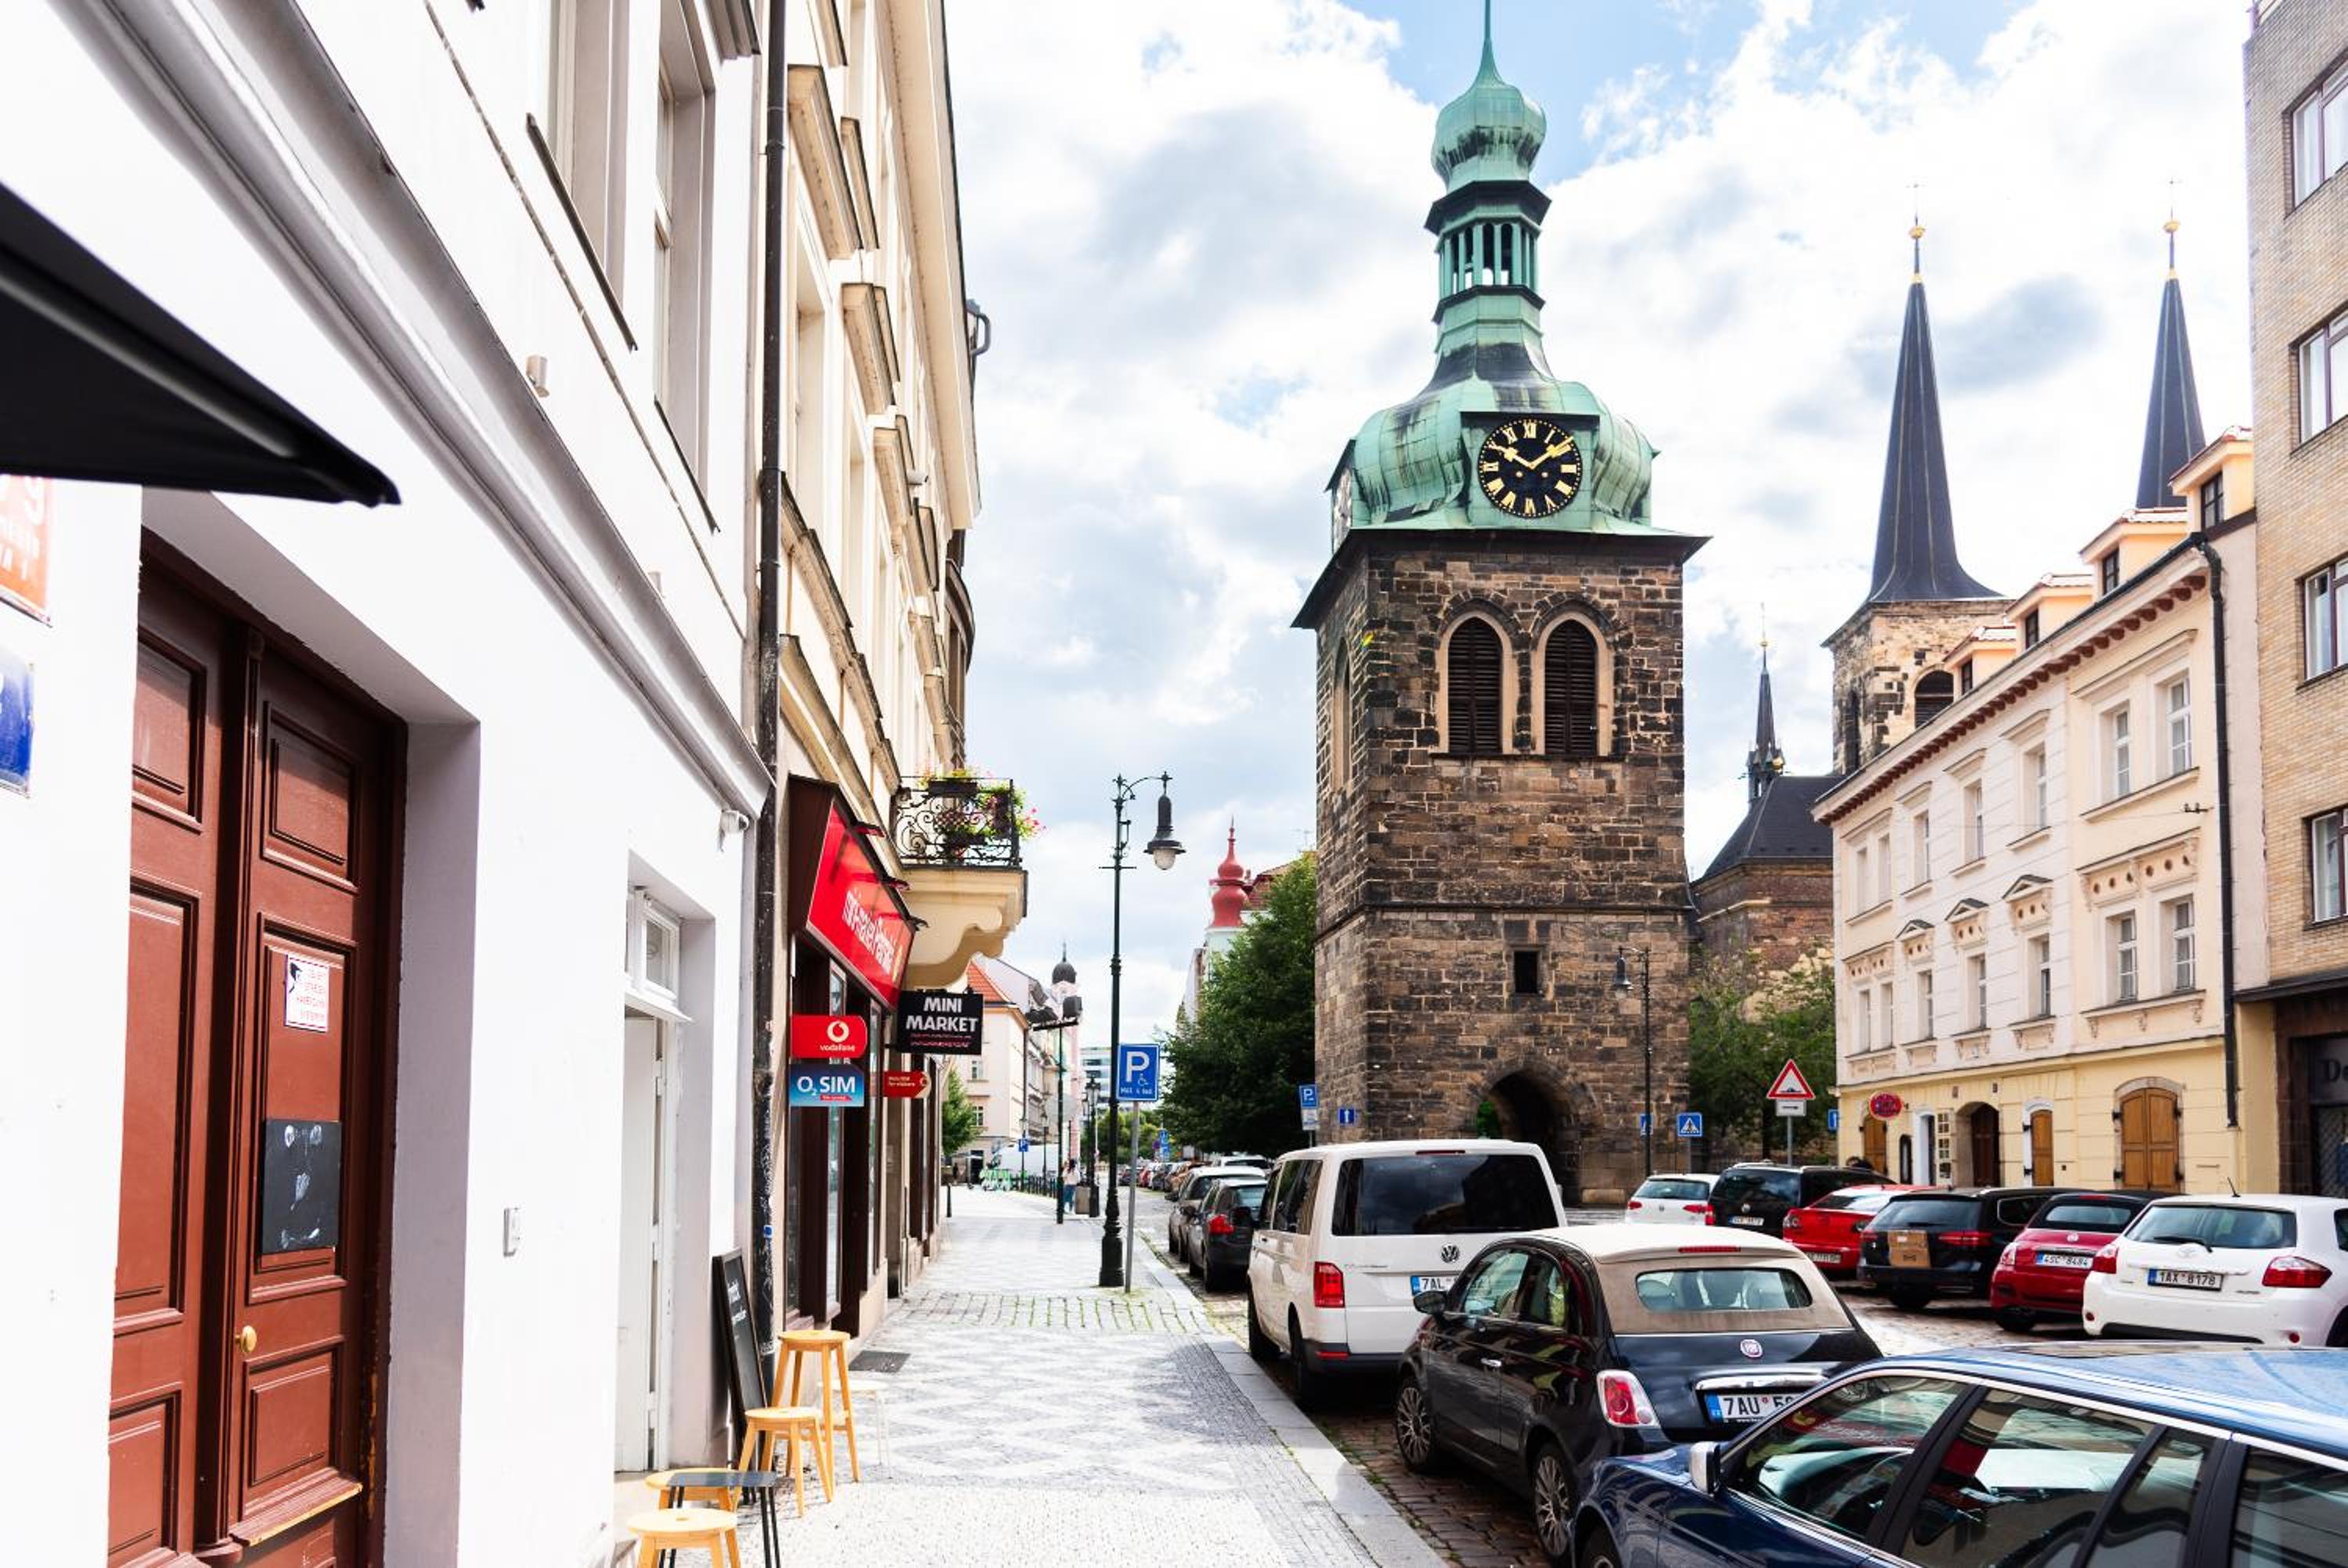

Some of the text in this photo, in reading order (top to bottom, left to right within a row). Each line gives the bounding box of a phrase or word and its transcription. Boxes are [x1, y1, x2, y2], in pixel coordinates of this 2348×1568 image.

[923, 997, 963, 1012] MINI
[906, 1016, 978, 1032] MARKET
[1126, 1051, 1150, 1082] P
[819, 1077, 855, 1093] SIM
[1421, 1278, 1446, 1290] 7AL
[1723, 1397, 1760, 1415] 7AU
